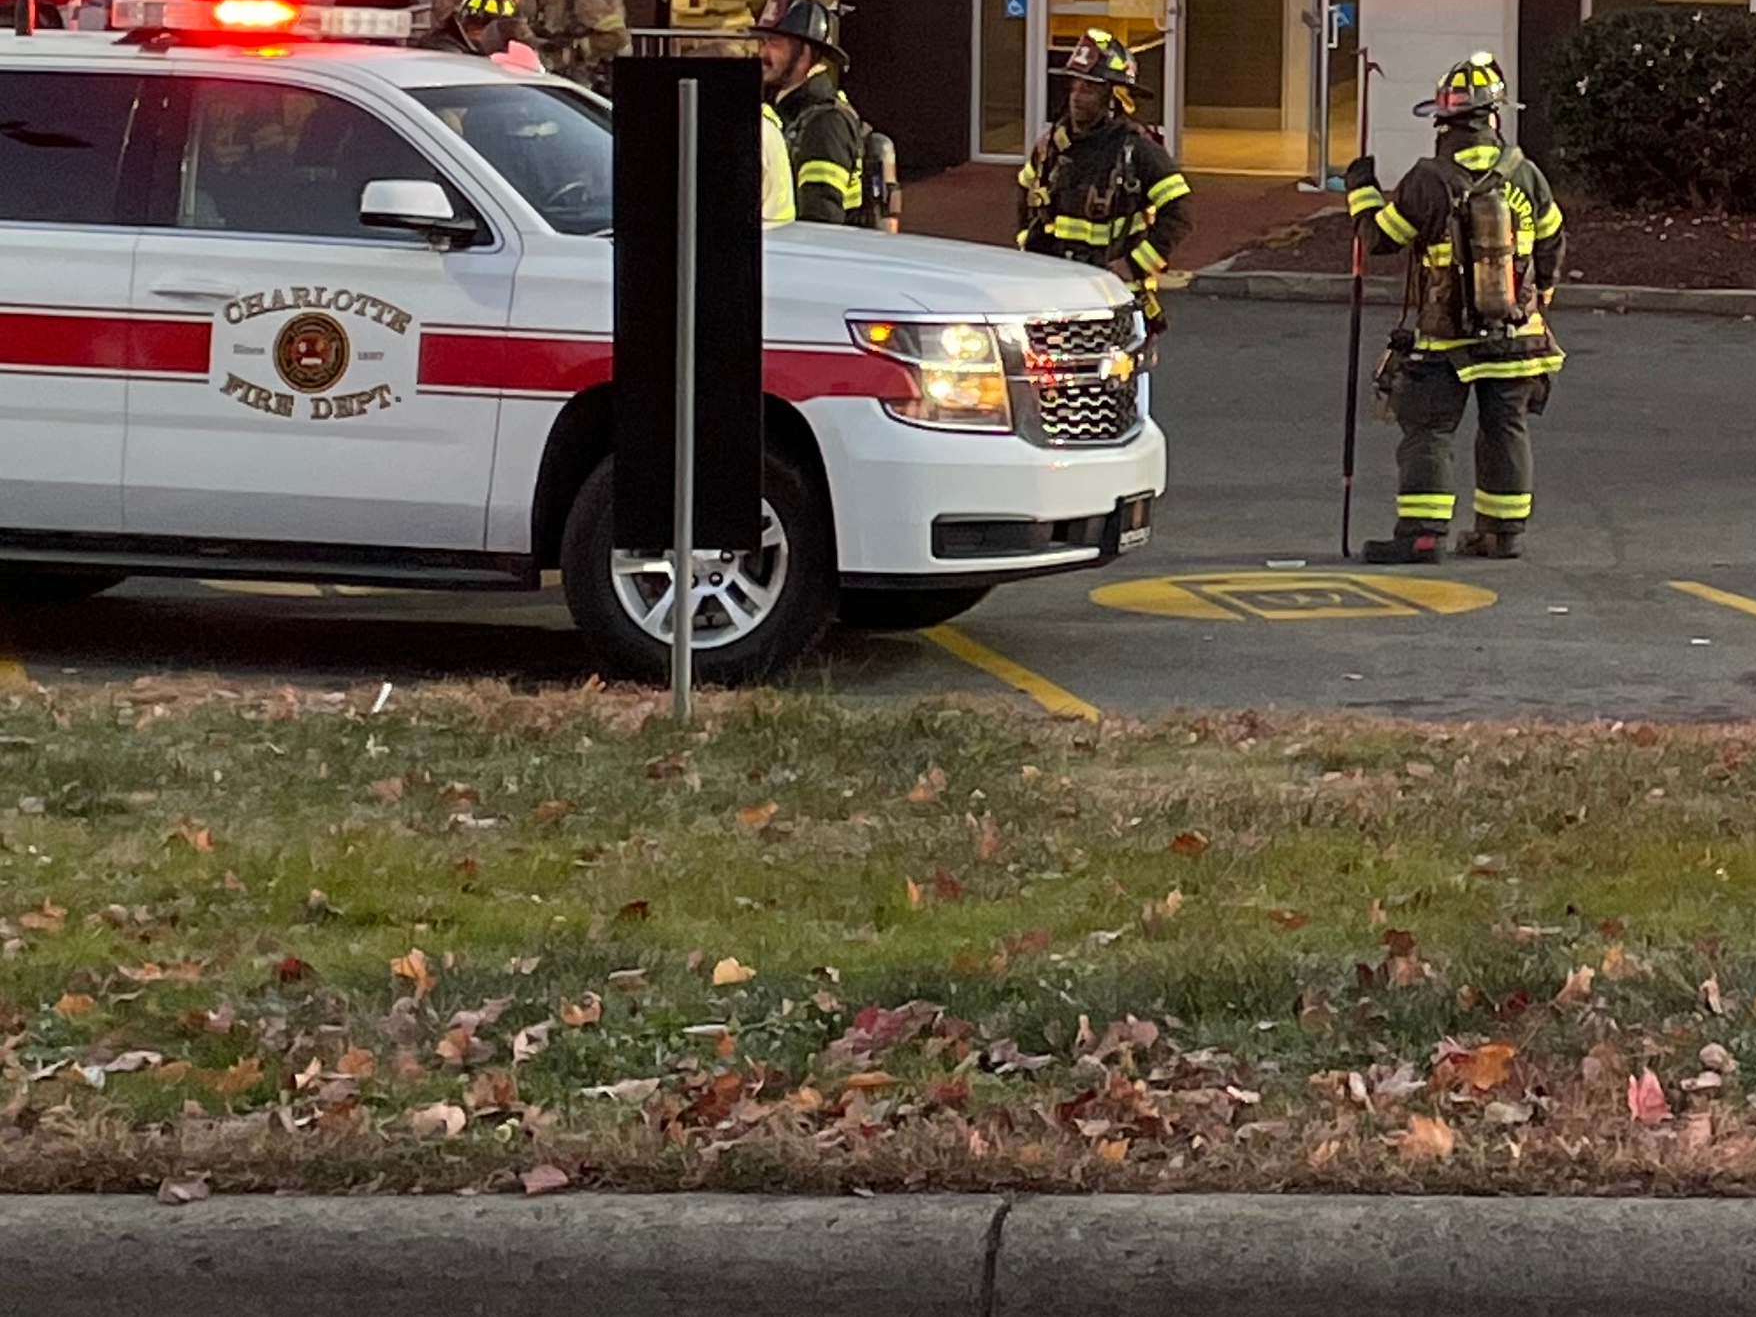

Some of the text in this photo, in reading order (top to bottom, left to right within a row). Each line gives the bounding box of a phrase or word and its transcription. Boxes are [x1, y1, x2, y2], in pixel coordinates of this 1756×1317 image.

[223, 286, 413, 335] CHARLOTTE
[219, 372, 402, 421] FIRE DEPT.
